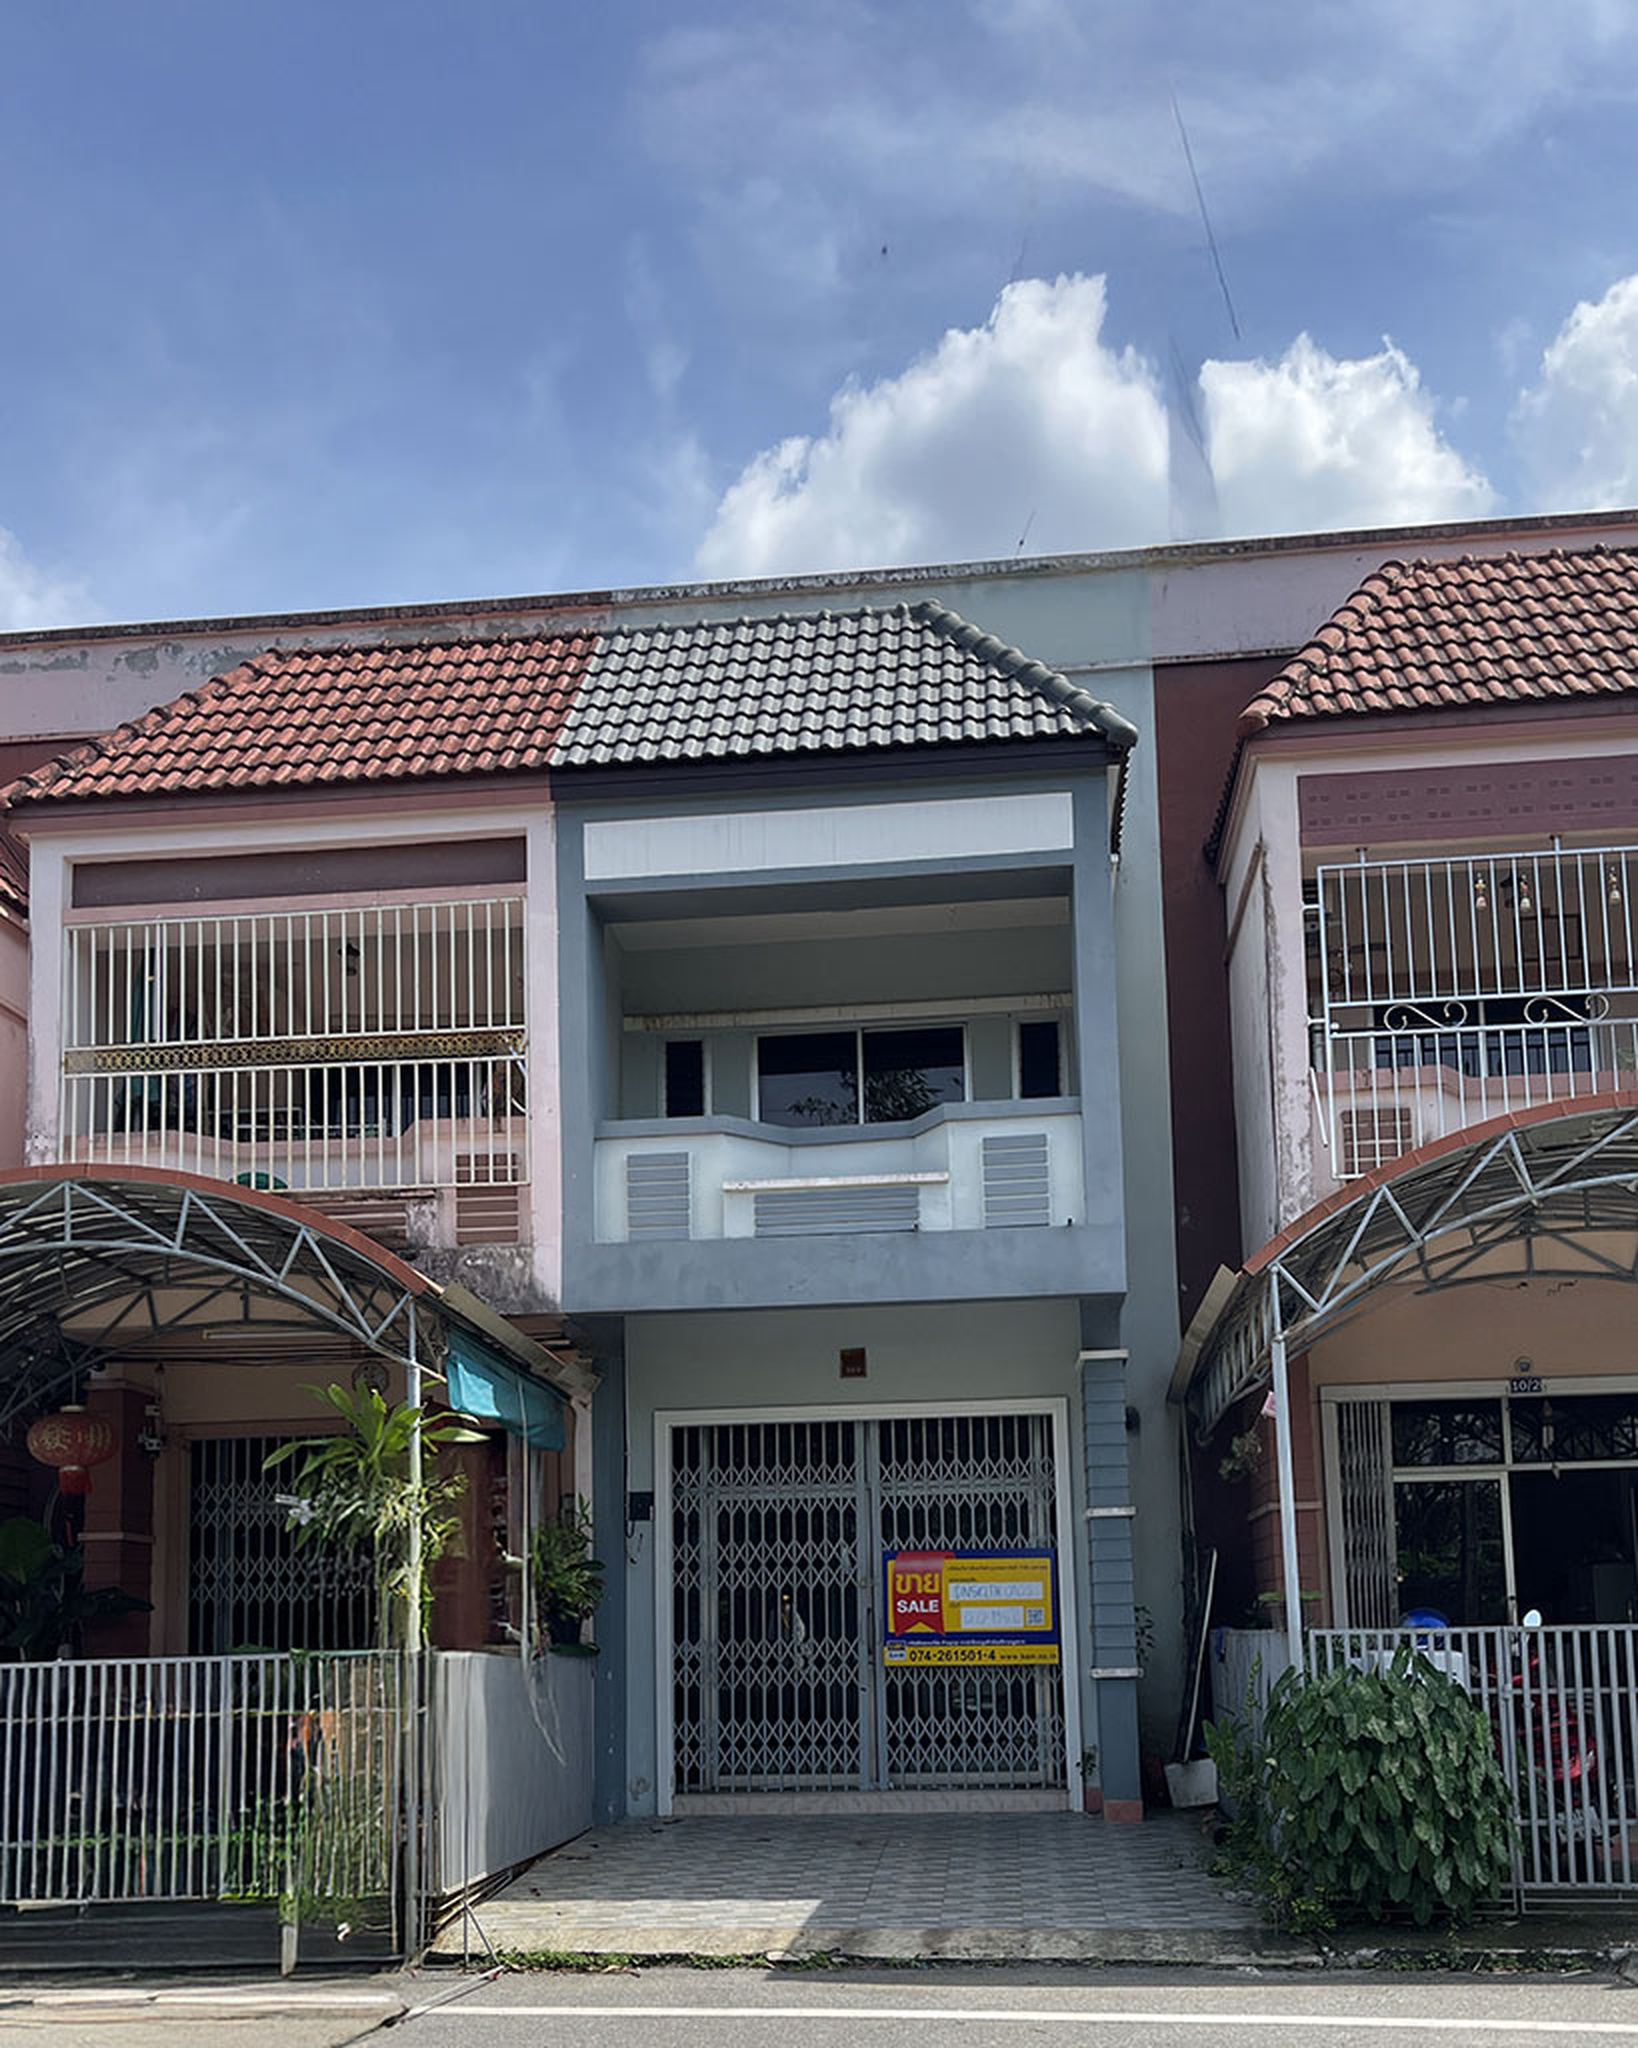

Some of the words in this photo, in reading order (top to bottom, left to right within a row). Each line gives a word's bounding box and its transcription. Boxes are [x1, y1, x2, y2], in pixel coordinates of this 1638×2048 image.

[1512, 1379, 1540, 1391] 10/2
[896, 1573, 940, 1594] ขาย
[896, 1599, 940, 1613] SALE
[909, 1649, 996, 1662] 074-261501-4
